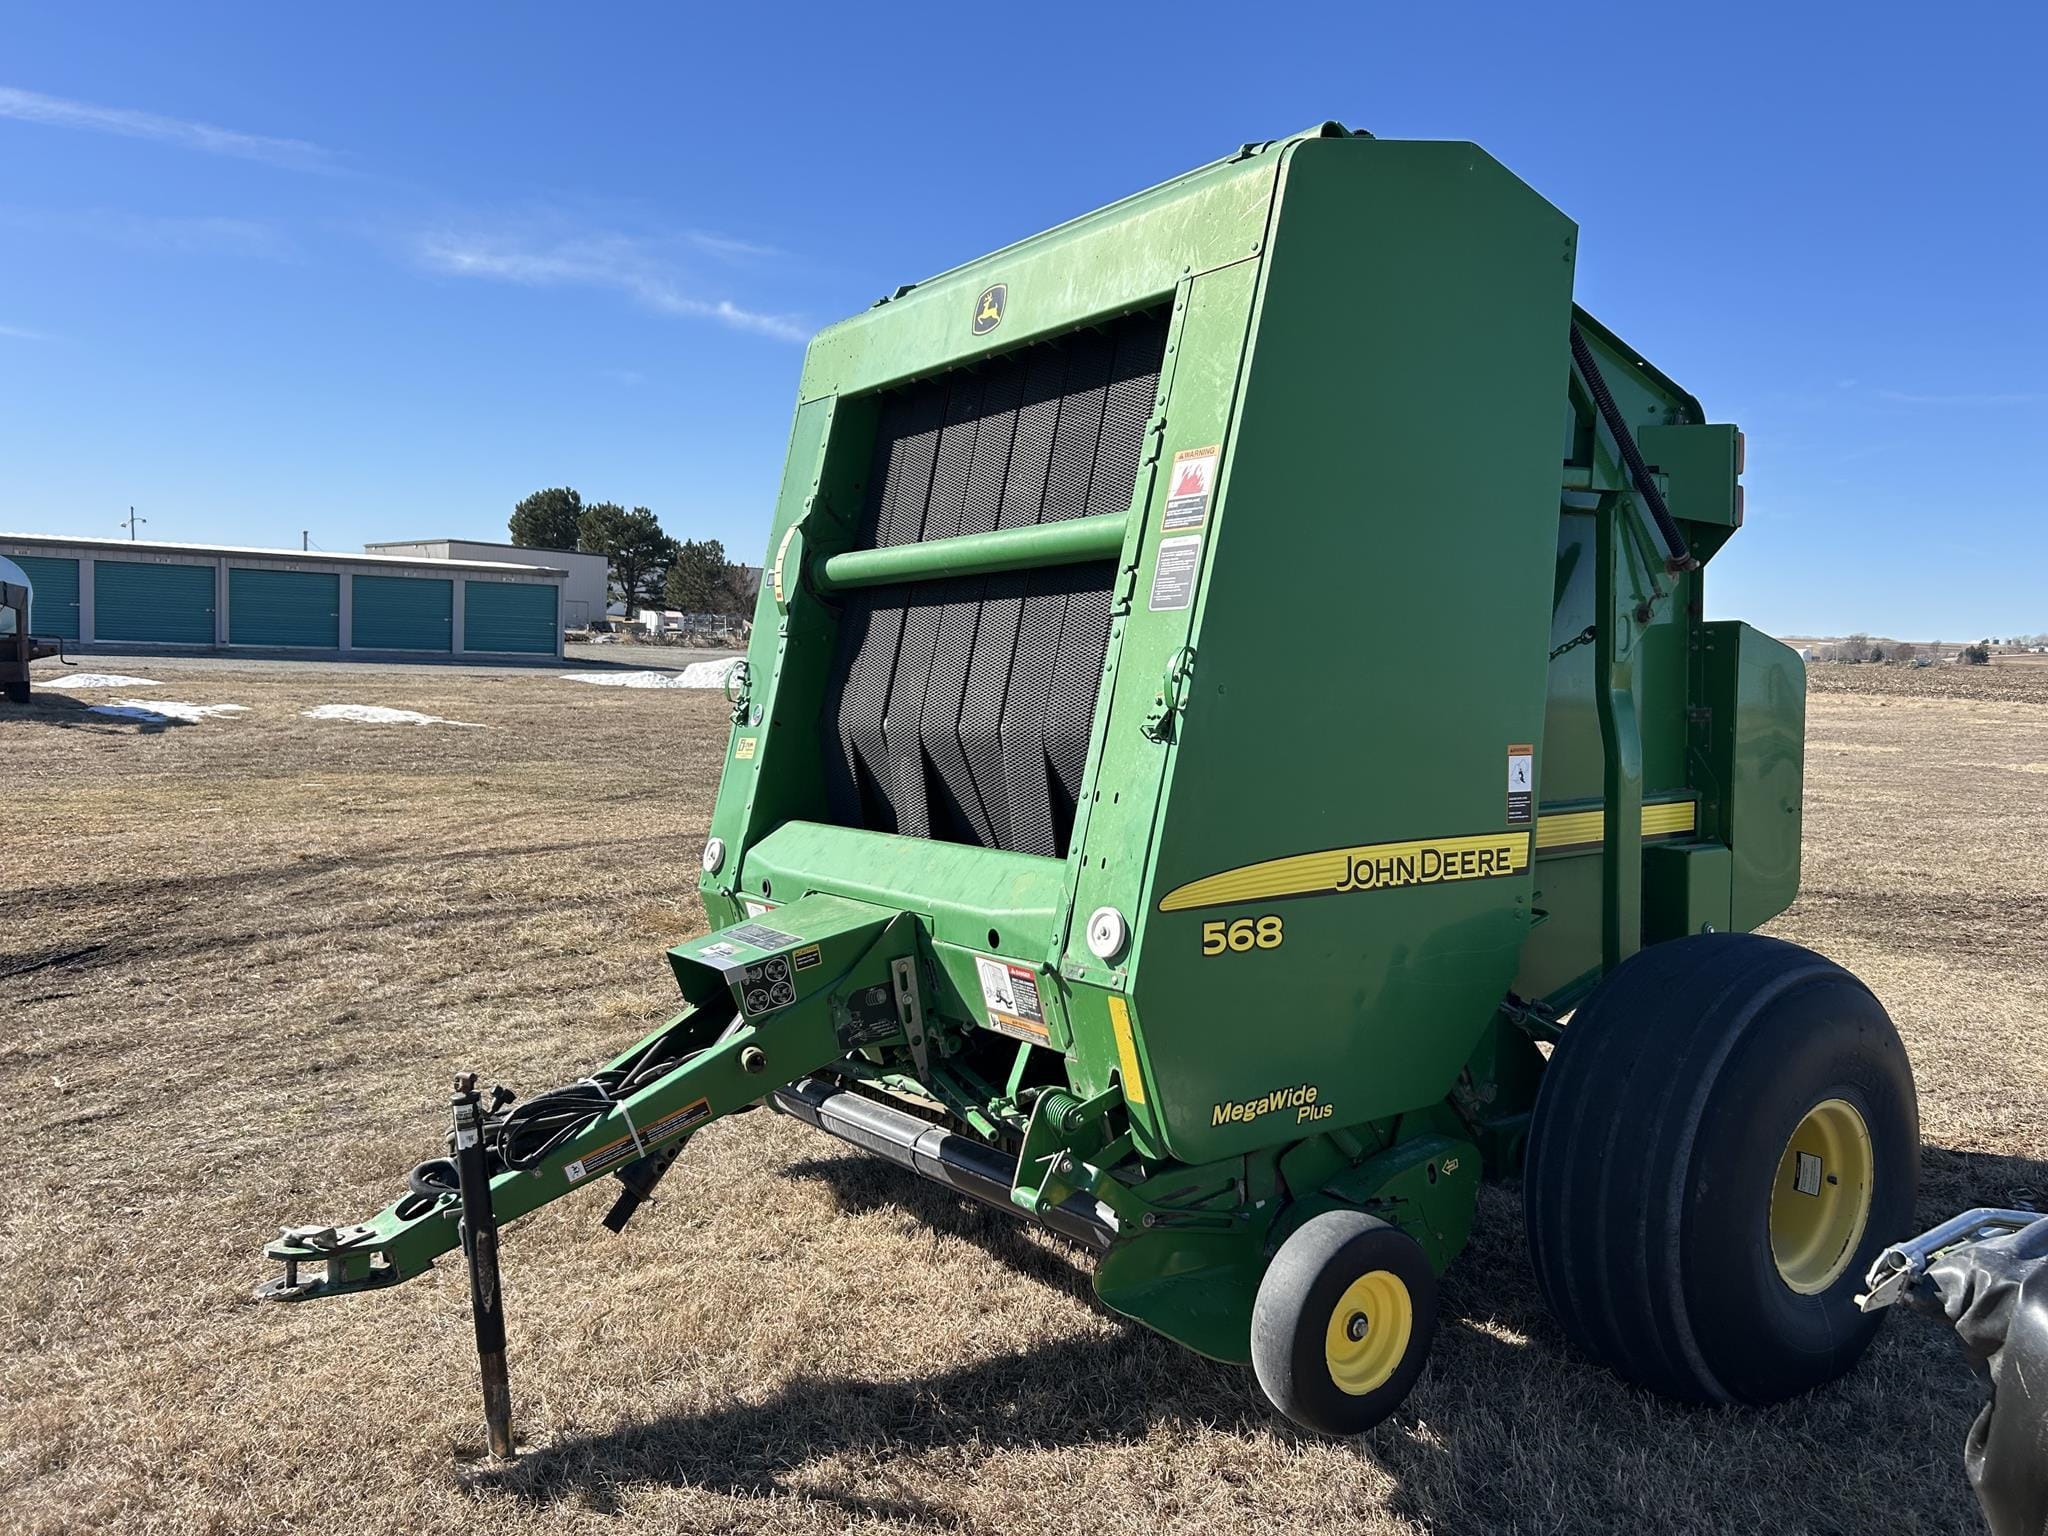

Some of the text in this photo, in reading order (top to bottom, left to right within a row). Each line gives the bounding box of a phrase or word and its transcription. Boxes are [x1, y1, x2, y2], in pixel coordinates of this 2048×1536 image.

[1184, 446, 1216, 458] WARNING
[1336, 848, 1512, 888] JOHN DEERE
[1202, 914, 1284, 956] 568
[1211, 1084, 1318, 1126] MegaWide
[1296, 1103, 1334, 1125] Plus
